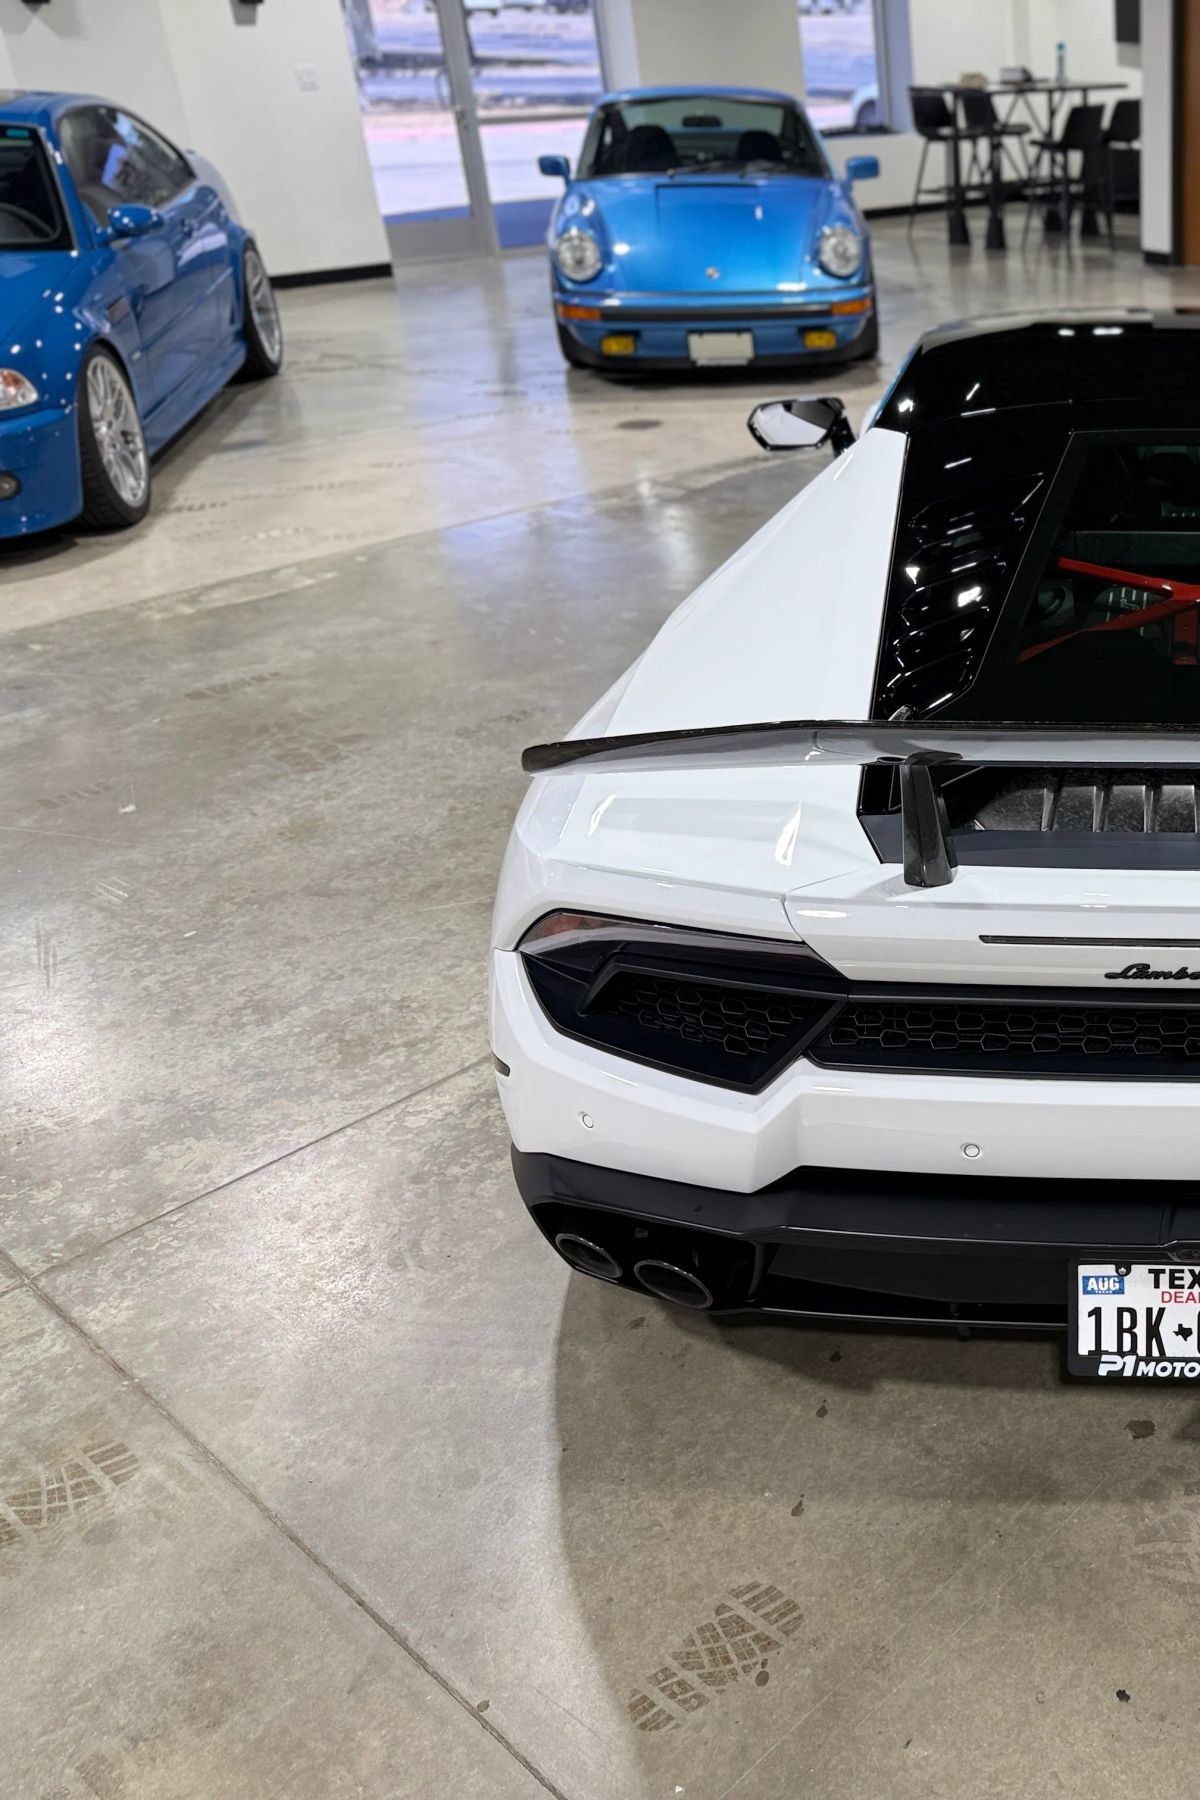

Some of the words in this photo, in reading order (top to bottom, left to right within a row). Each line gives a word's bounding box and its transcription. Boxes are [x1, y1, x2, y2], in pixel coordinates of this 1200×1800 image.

[1087, 1277, 1120, 1291] AUG
[1087, 1306, 1167, 1358] 1BK
[1097, 1354, 1137, 1377] P1
